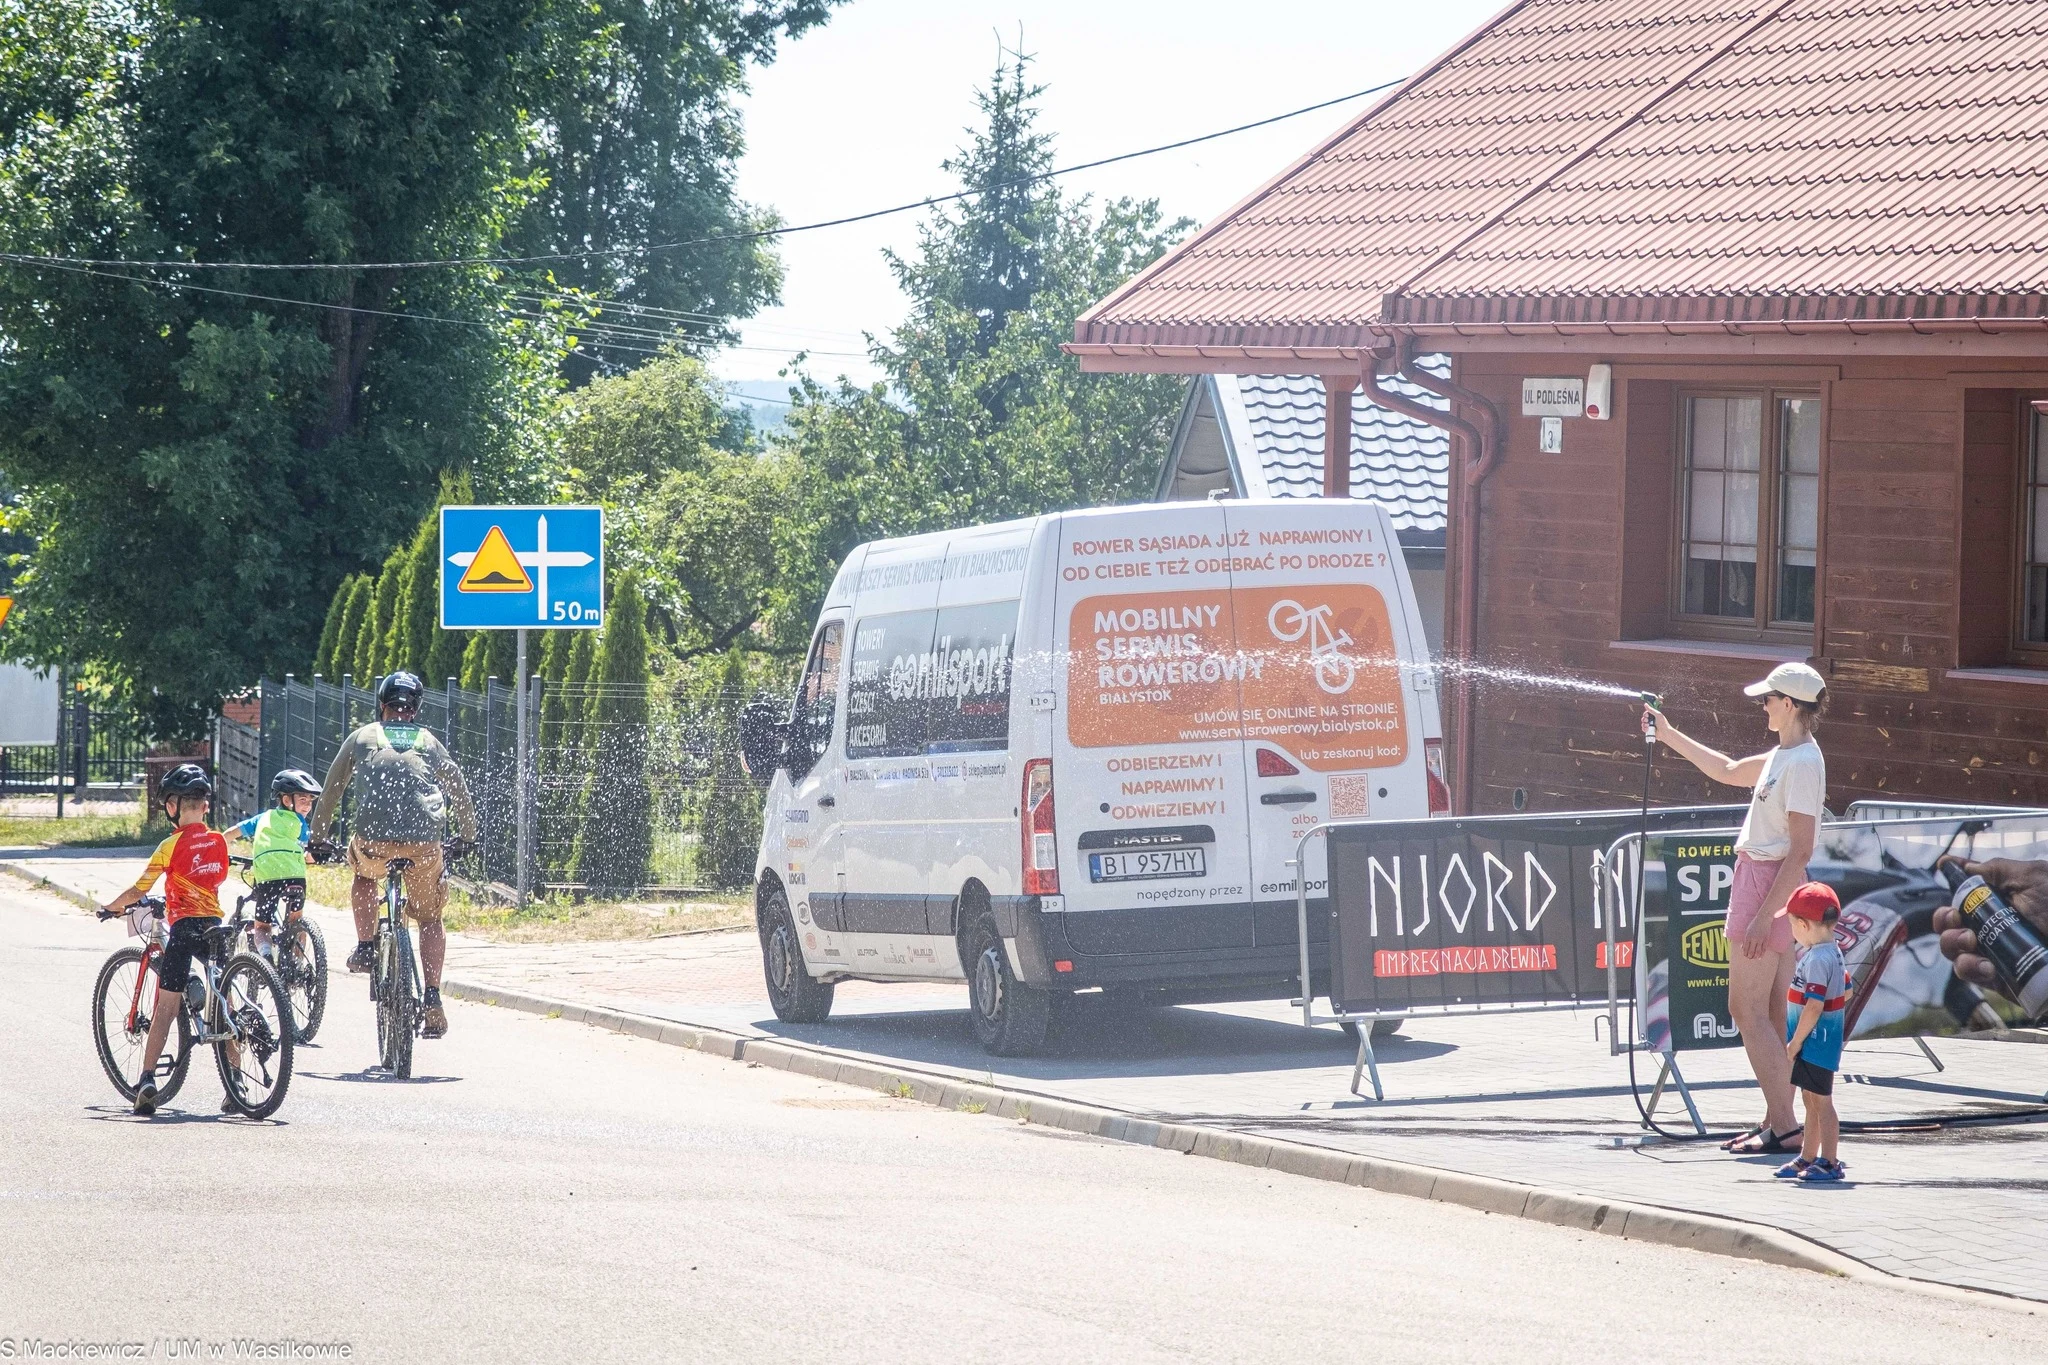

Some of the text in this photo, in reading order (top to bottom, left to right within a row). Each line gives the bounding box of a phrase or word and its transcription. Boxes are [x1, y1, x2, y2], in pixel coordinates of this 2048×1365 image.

[1537, 387, 1580, 405] PODLEŚNA
[1547, 430, 1554, 449] 3
[1072, 538, 1134, 556] ROWER
[1138, 534, 1212, 554] SĄSIADA
[1216, 529, 1250, 548] JUŻ
[1259, 529, 1364, 546] NAPRAWIONY
[882, 562, 911, 589] SERWIS
[1062, 552, 1387, 582] OD CIEBIE TEŻ ODEBRAĆ PO DRODZE ?
[553, 600, 599, 621] 50 m
[1094, 604, 1221, 634] MOBILNY
[855, 628, 886, 651] ROWERY
[1095, 632, 1203, 661] SERWIS
[1098, 656, 1265, 689] ROWEROWY
[1100, 688, 1172, 705] BIAŁYSTOK
[1193, 702, 1399, 724] UMÓW SIĘ ONLINE NA STRONIE:
[848, 724, 887, 747] AKCESORIA
[1178, 718, 1400, 740] www.serwisrowerowy.bialystok.pl
[1106, 753, 1214, 773] ODBIERZEMY
[1300, 745, 1401, 760] lub zeskanuj kod:
[1121, 776, 1216, 796] NAPRAWIMY
[1111, 800, 1217, 820] ODWIEZIEMY
[1291, 813, 1319, 825] albo
[1113, 833, 1183, 845] MASTER
[1677, 845, 1731, 858] ROWER
[1104, 851, 1197, 876] BI 957HY
[1136, 885, 1243, 902] napędzany przez
[1368, 850, 1557, 937] NJORD
[1676, 864, 1734, 902] SP
[1985, 914, 2020, 946] COATING
[1682, 927, 1730, 962] FENW
[1381, 947, 1550, 976] IMPREGNACJA DREWNA
